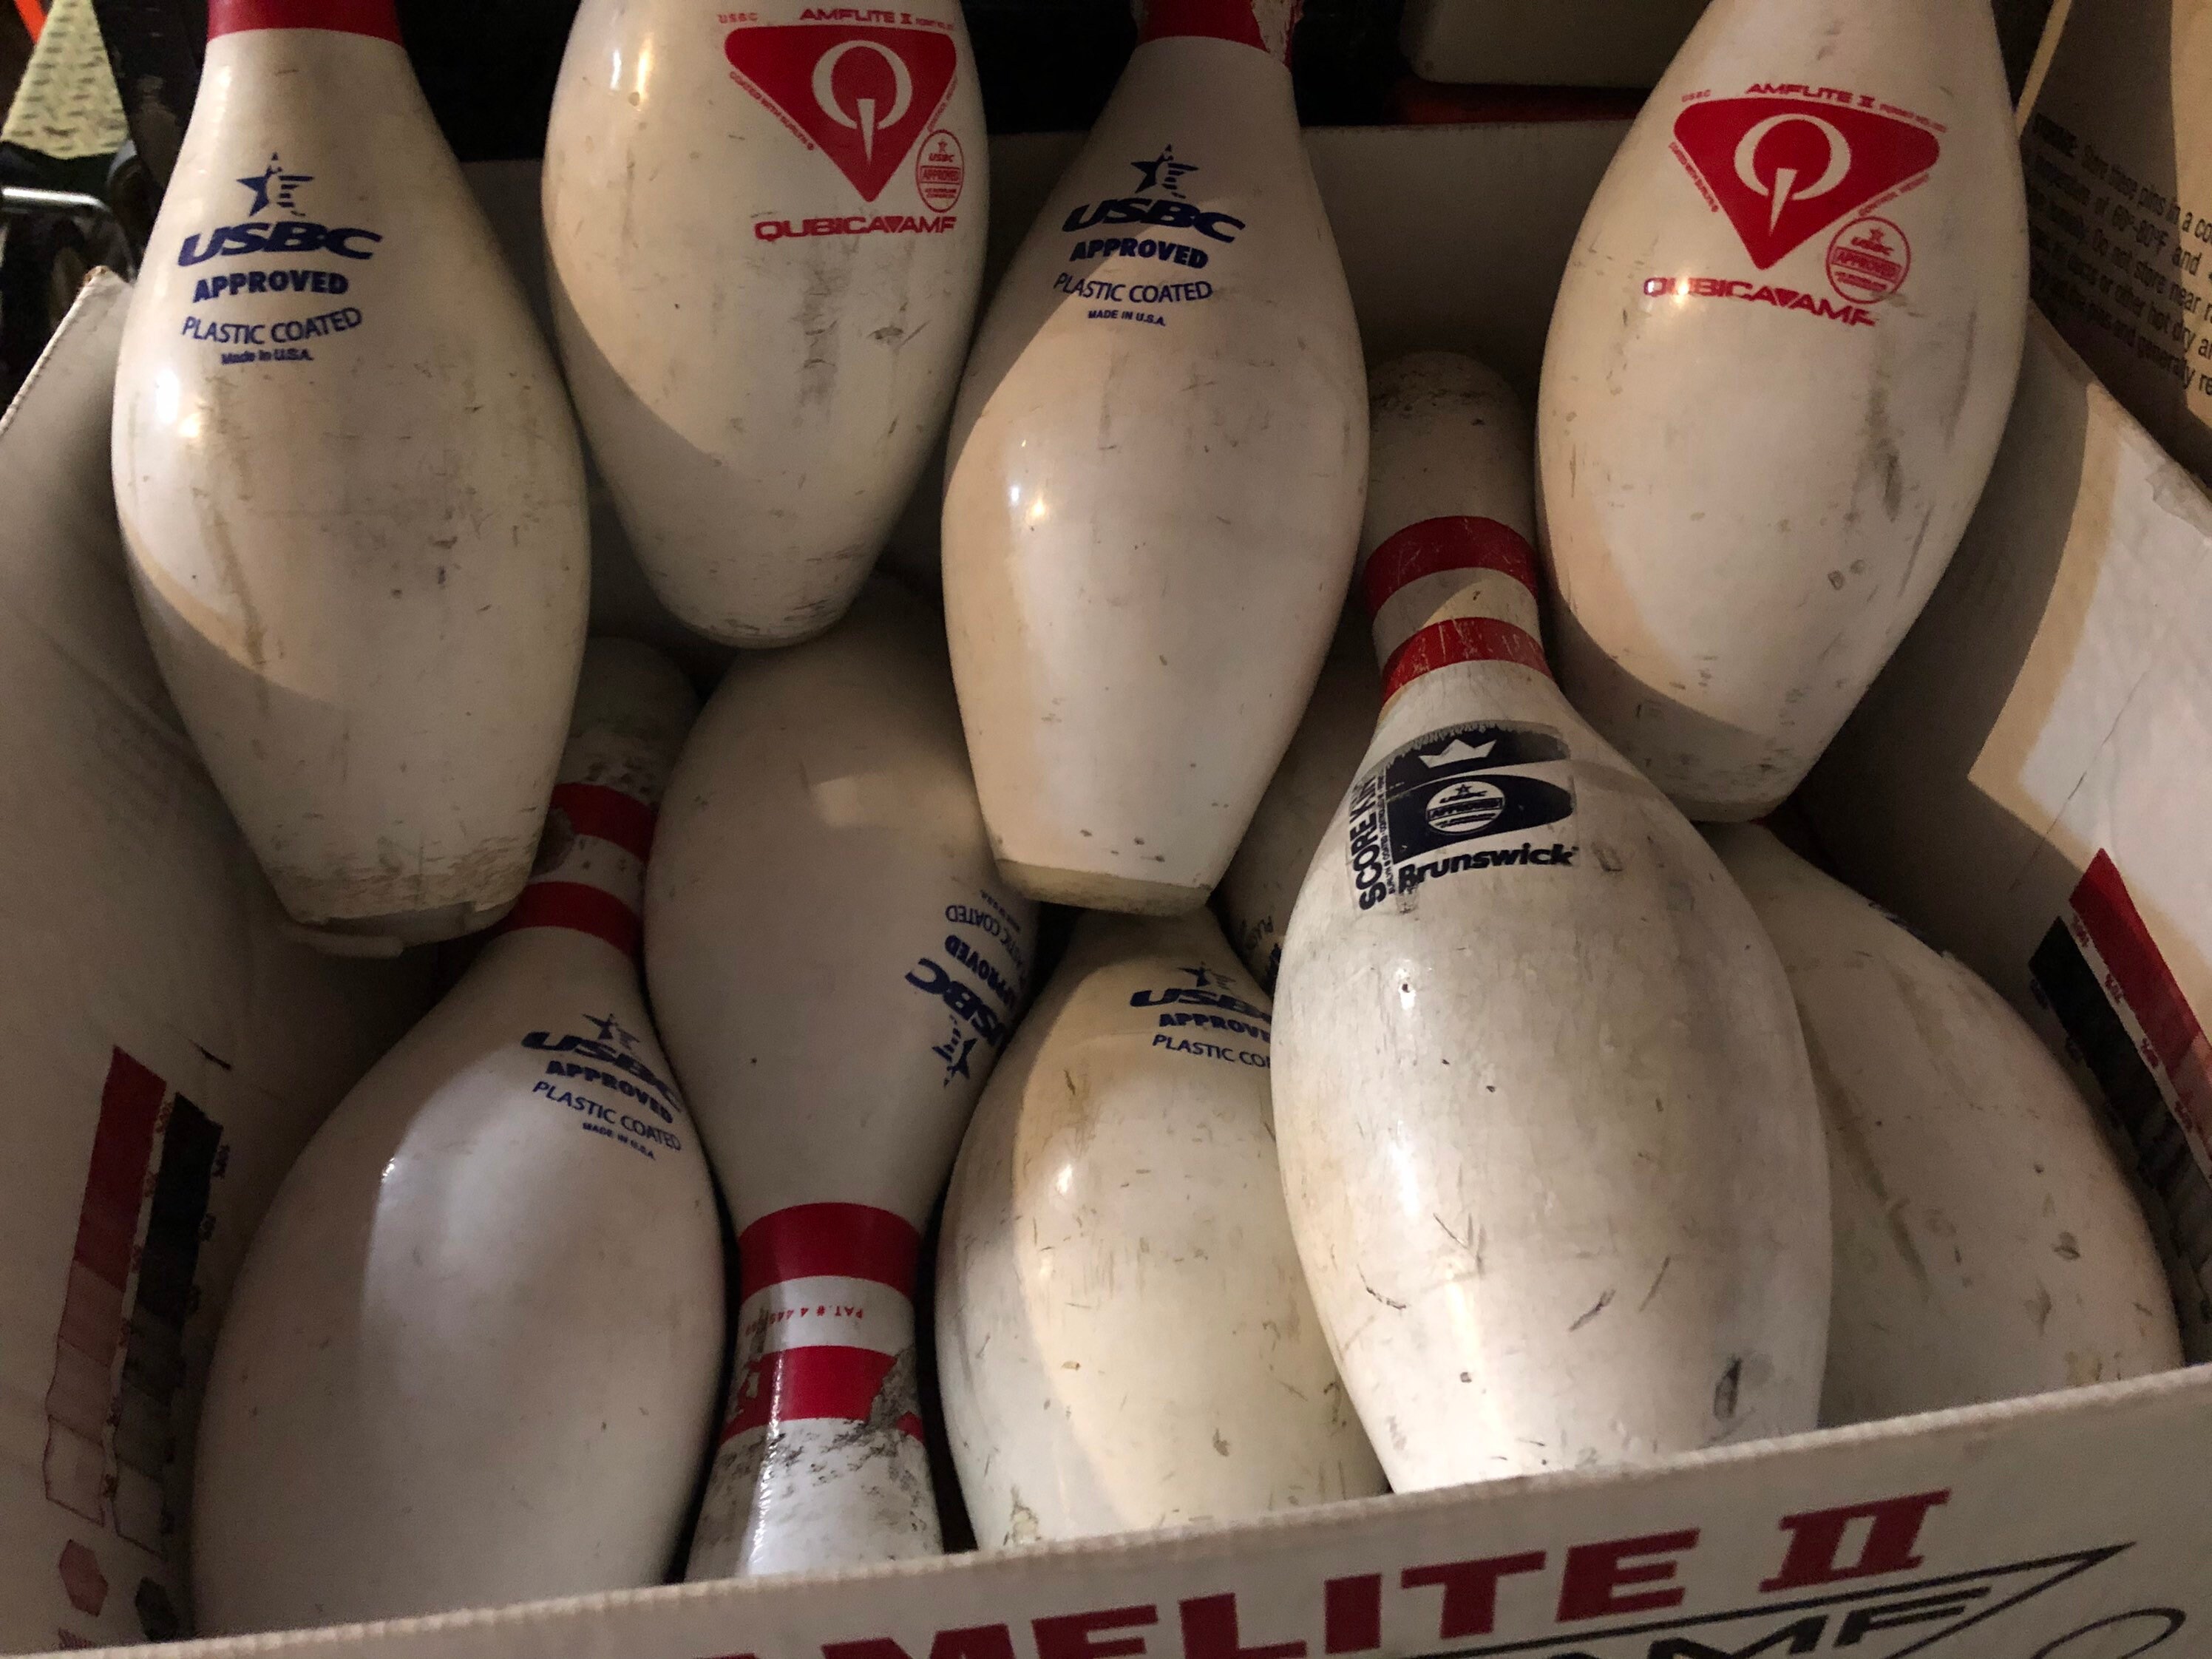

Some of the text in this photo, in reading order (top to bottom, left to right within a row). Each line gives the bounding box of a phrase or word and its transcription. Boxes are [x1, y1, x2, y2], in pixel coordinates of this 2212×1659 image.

[1062, 197, 1246, 243] USBC
[2182, 211, 2193, 232] a
[2194, 217, 2212, 244] co
[177, 221, 383, 267] USBC
[1069, 238, 1208, 268] APPROVED
[2172, 245, 2202, 276] and
[193, 270, 349, 302] APPROVED
[1054, 272, 1213, 302] PLASTIC COATED
[2169, 281, 2201, 313] near
[182, 308, 362, 345] PLASTIC COATED
[1088, 310, 1119, 319] MADE
[1122, 311, 1133, 320] IN
[1350, 812, 1387, 911] SCORE
[1397, 842, 1573, 894] Brunswick
[946, 905, 1000, 937] COATED
[1152, 1034, 1235, 1062] PLASTIC
[521, 1031, 681, 1112] USBC
[546, 1060, 673, 1123] APPROVED
[532, 1081, 682, 1150] PLASTIC COATED
[583, 1122, 613, 1137] MADE
[816, 1305, 826, 1317] #
[693, 1528, 1700, 1659] FLITE
